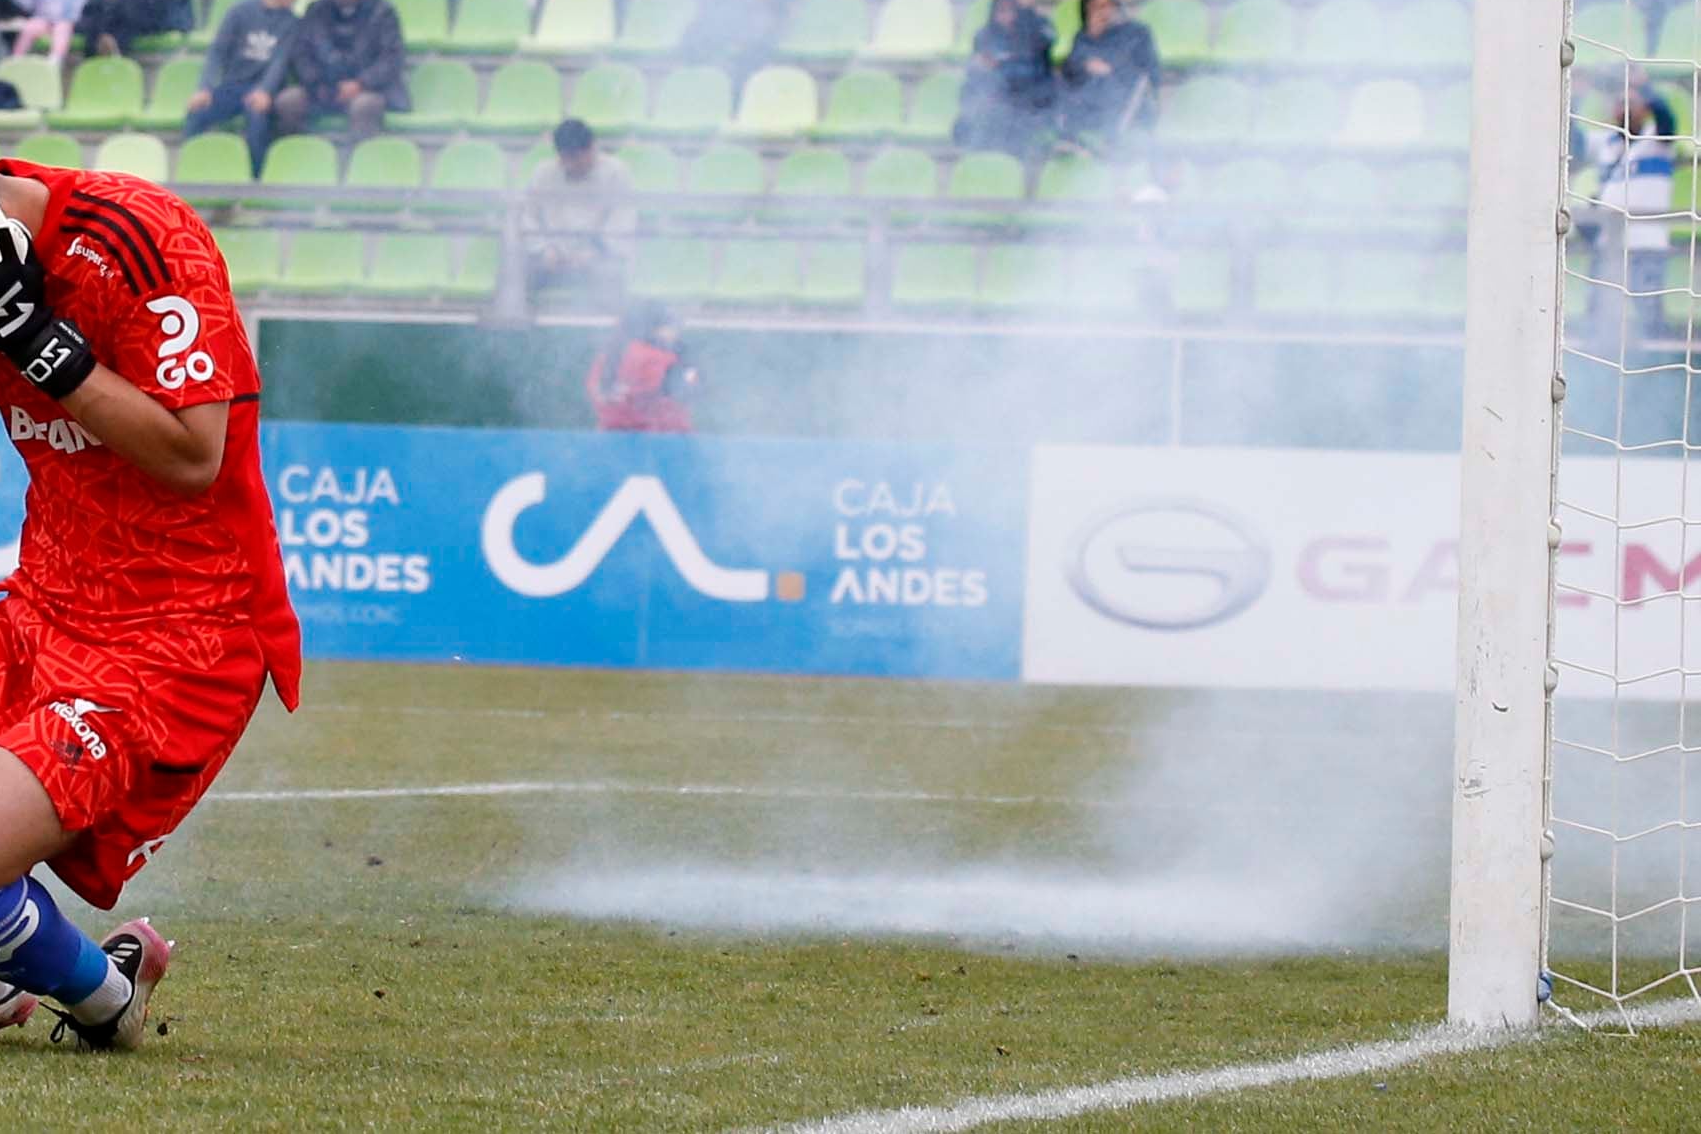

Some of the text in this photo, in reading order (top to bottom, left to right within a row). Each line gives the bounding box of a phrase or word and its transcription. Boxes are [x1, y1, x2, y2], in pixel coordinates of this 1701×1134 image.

[156, 351, 214, 389] GO
[278, 464, 400, 505] CAJA
[832, 478, 956, 517] CAJA
[281, 508, 370, 548] LOS
[834, 522, 926, 562] LOS
[284, 553, 431, 594] ANDES
[830, 568, 989, 606] ANDES
[49, 701, 107, 760] rexona
